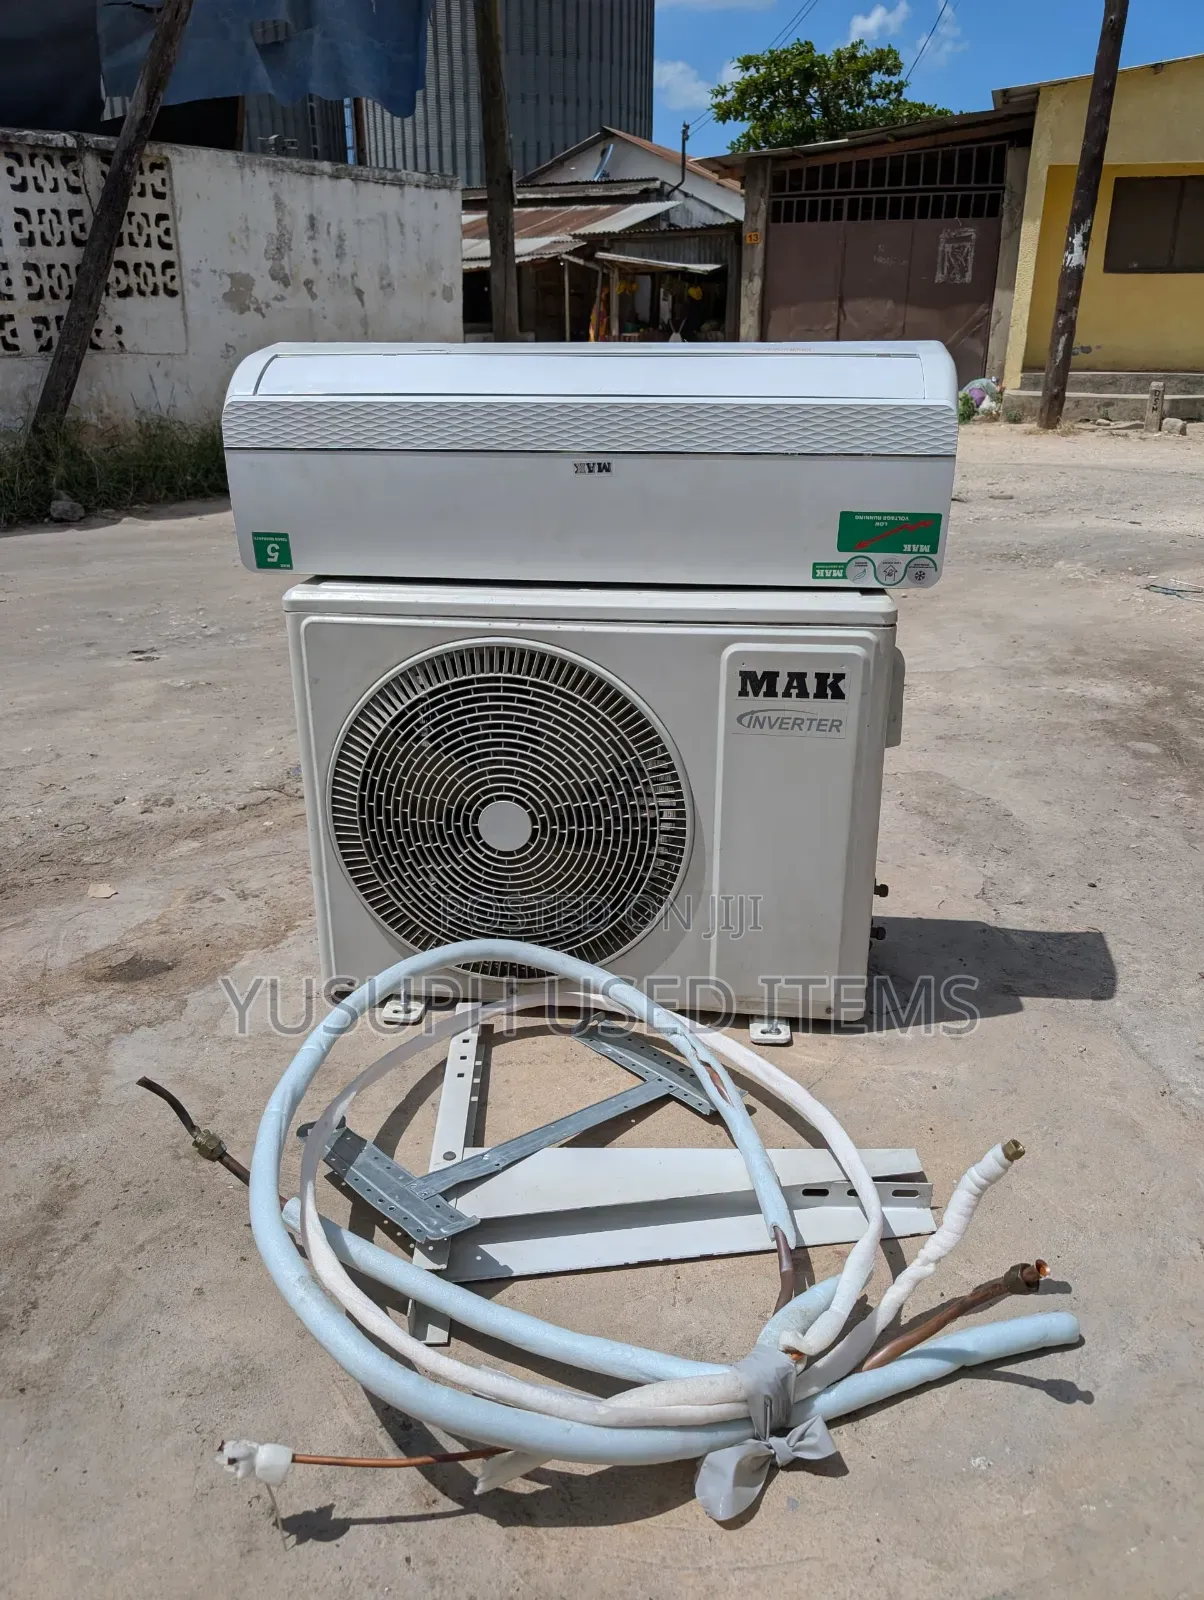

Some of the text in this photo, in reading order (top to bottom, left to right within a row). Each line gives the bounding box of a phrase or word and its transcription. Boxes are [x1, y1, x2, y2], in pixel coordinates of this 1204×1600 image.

[747, 233, 759, 243] 13
[574, 462, 612, 474] MAK
[266, 543, 280, 563] 5
[902, 544, 931, 553] MAK
[815, 569, 844, 578] MAK
[738, 670, 846, 700] MAK
[747, 715, 843, 733] INVERTER
